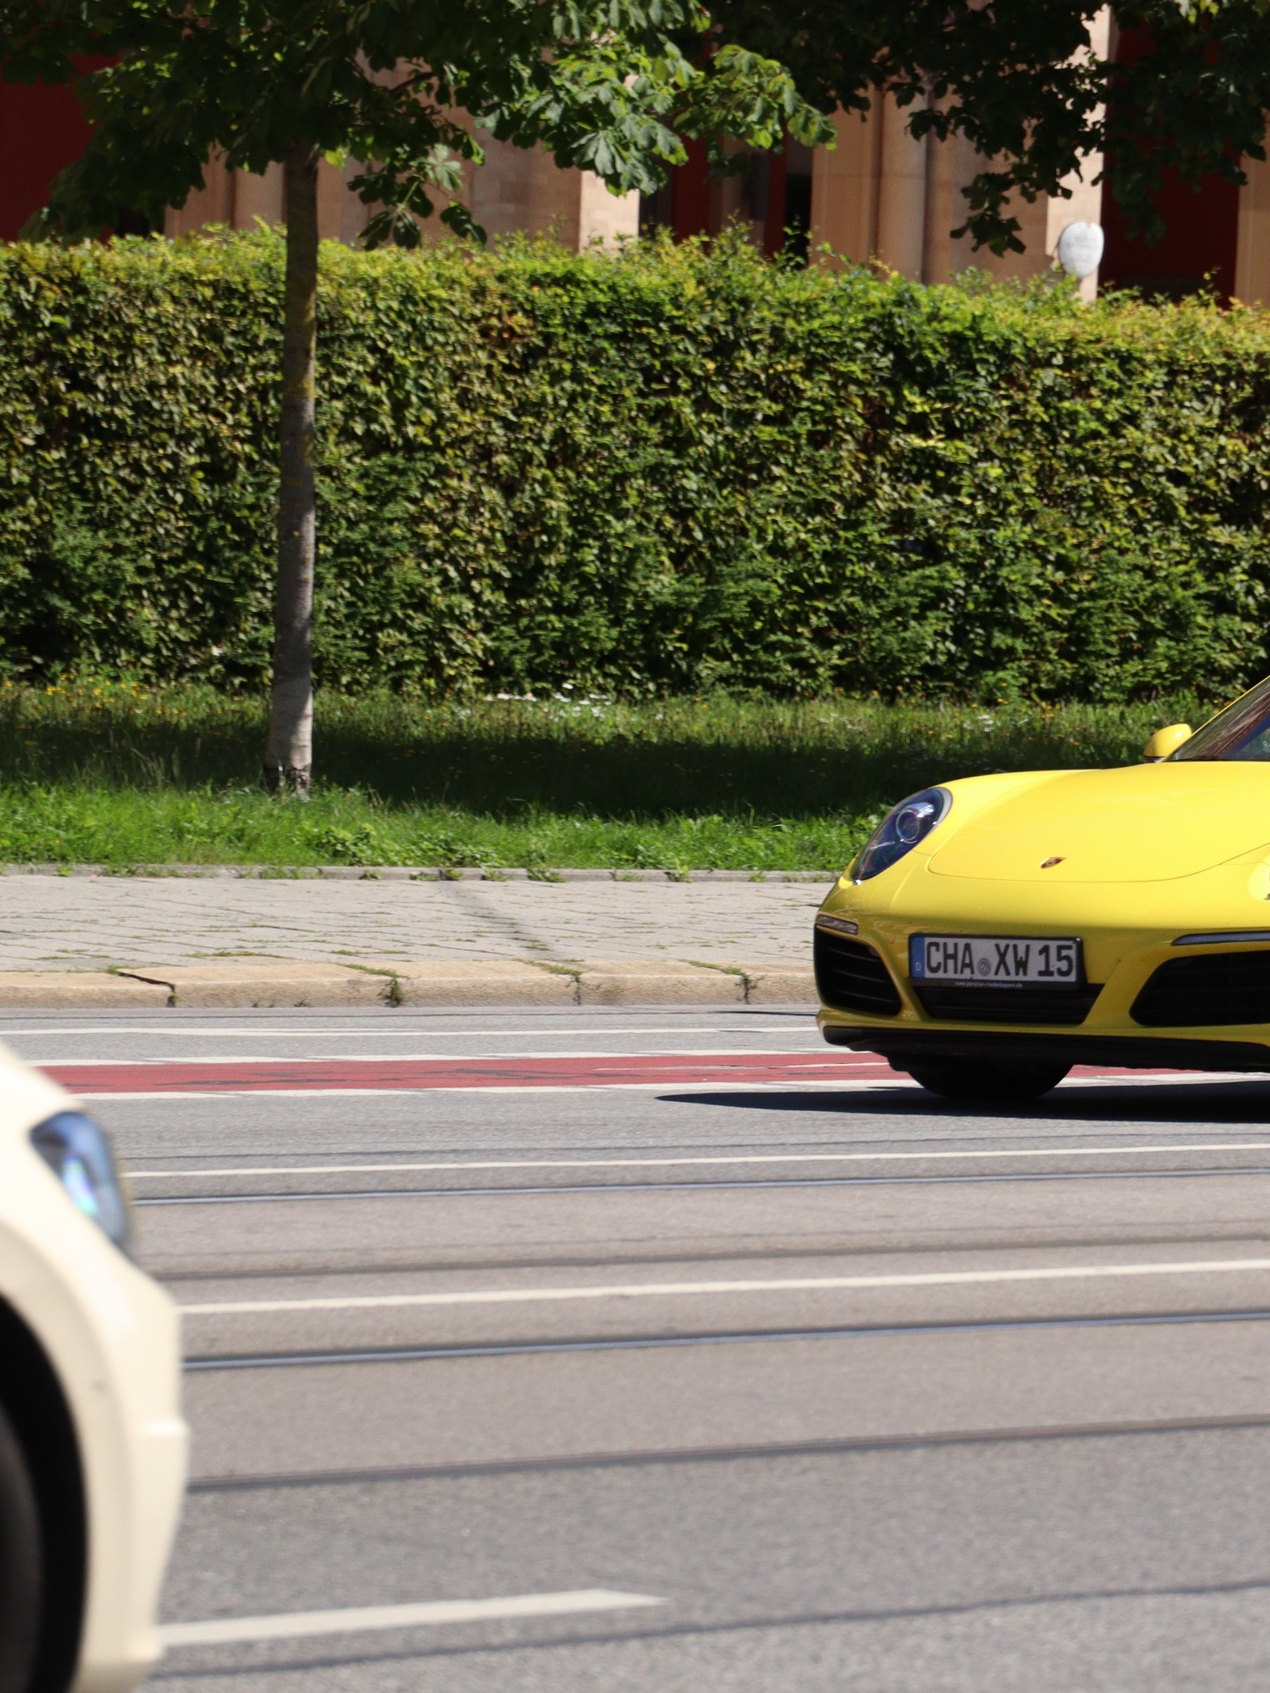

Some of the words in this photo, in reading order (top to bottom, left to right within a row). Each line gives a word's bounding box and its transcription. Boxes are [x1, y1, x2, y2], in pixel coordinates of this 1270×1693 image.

[915, 962, 921, 971] D
[926, 941, 975, 974] CHA
[994, 943, 1030, 976] XW
[1037, 944, 1073, 977] 15
